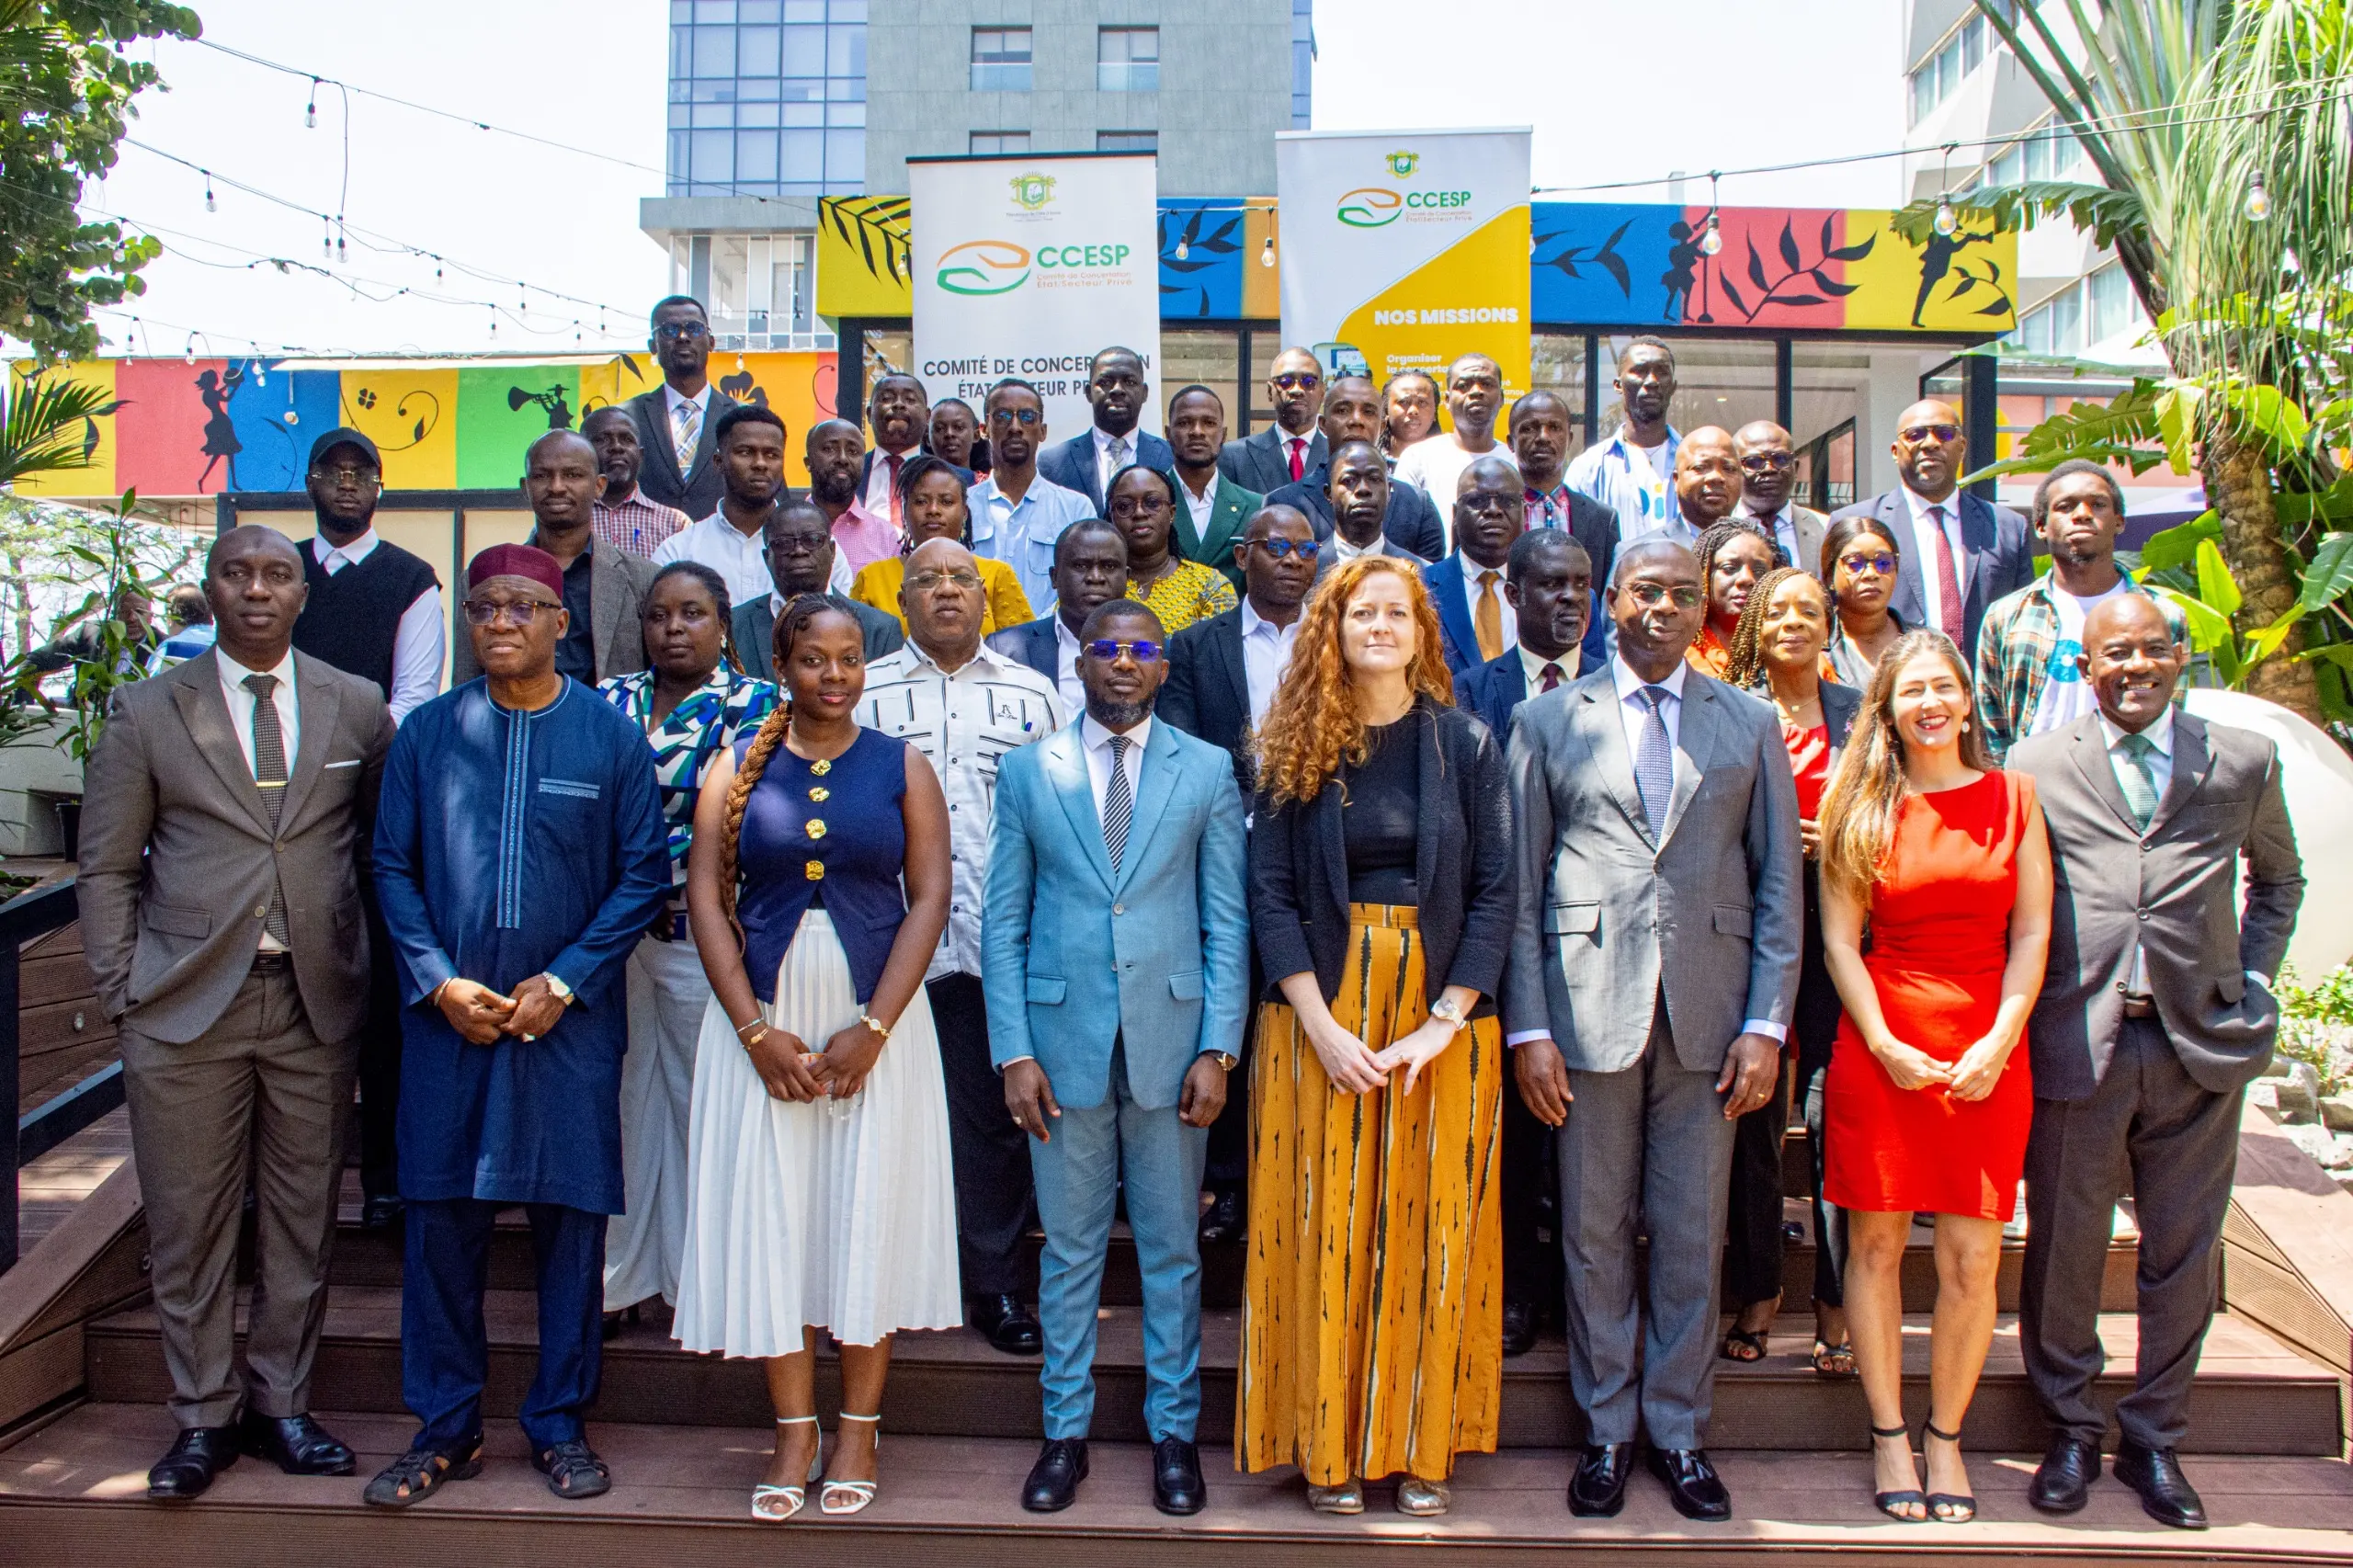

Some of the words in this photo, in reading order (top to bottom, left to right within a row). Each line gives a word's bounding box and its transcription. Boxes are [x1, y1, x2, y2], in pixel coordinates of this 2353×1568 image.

[1405, 191, 1472, 209] CCESP
[1037, 244, 1130, 268] CCESP
[1374, 309, 1417, 325] NOS
[1420, 307, 1518, 324] MISSIONS
[924, 355, 987, 376] COMITÉ
[994, 359, 1015, 375] DE
[1386, 353, 1442, 366] Organiser
